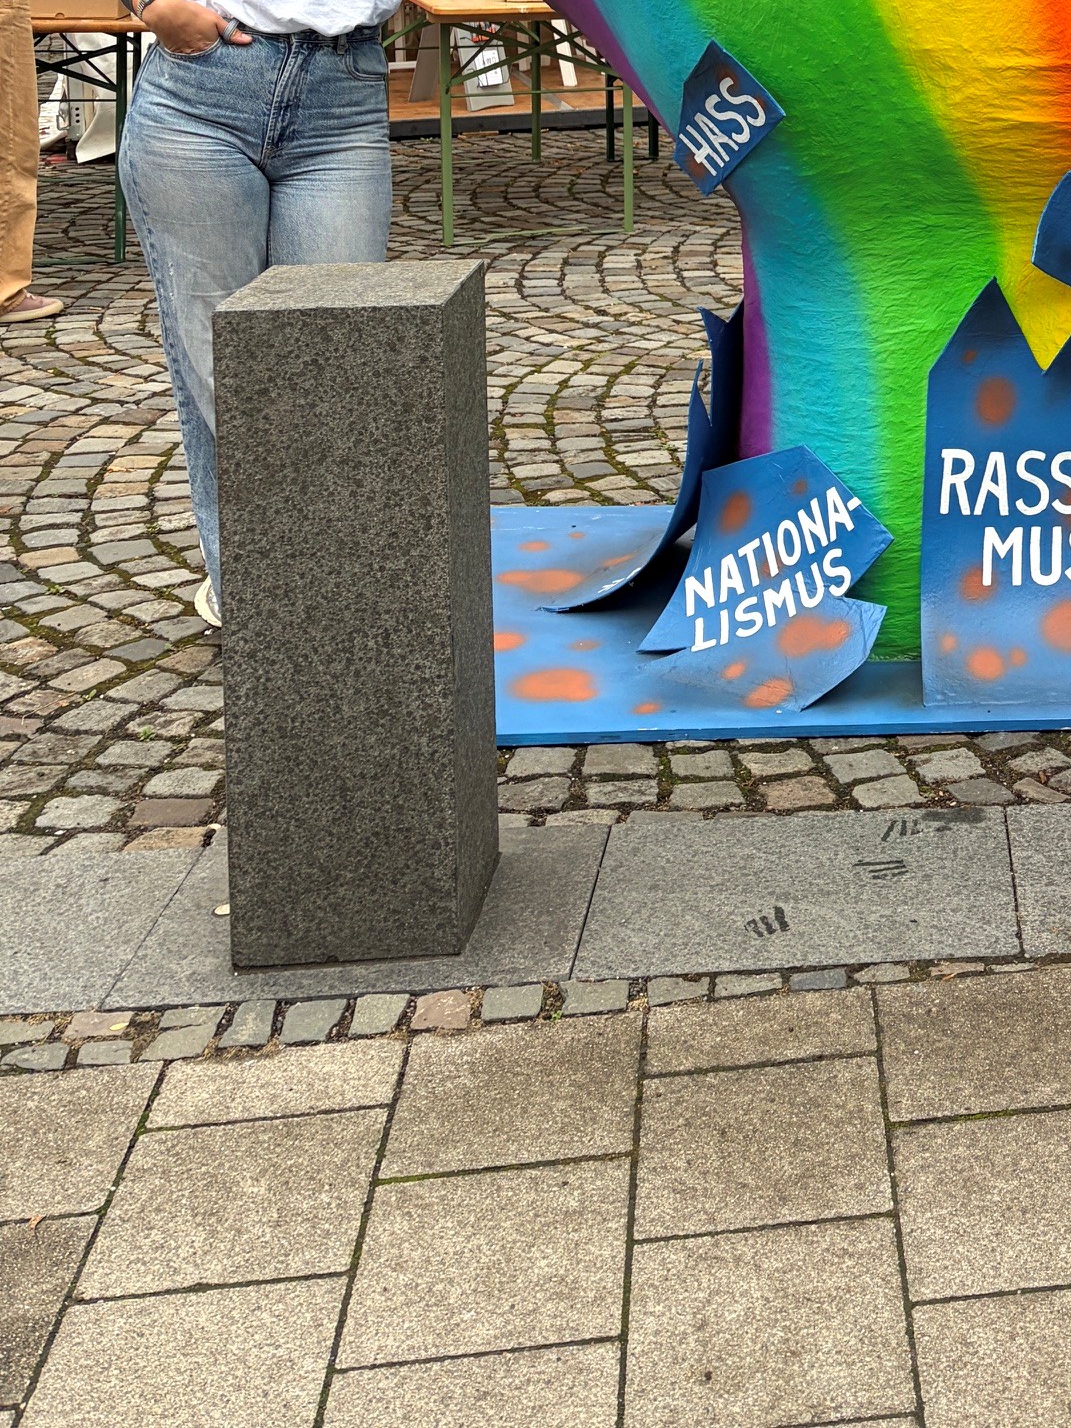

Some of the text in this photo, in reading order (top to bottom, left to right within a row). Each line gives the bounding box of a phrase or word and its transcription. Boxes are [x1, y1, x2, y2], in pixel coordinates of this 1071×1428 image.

[678, 76, 766, 177] HASS
[684, 486, 862, 618] NATIONA-
[690, 548, 852, 652] LISMUS
